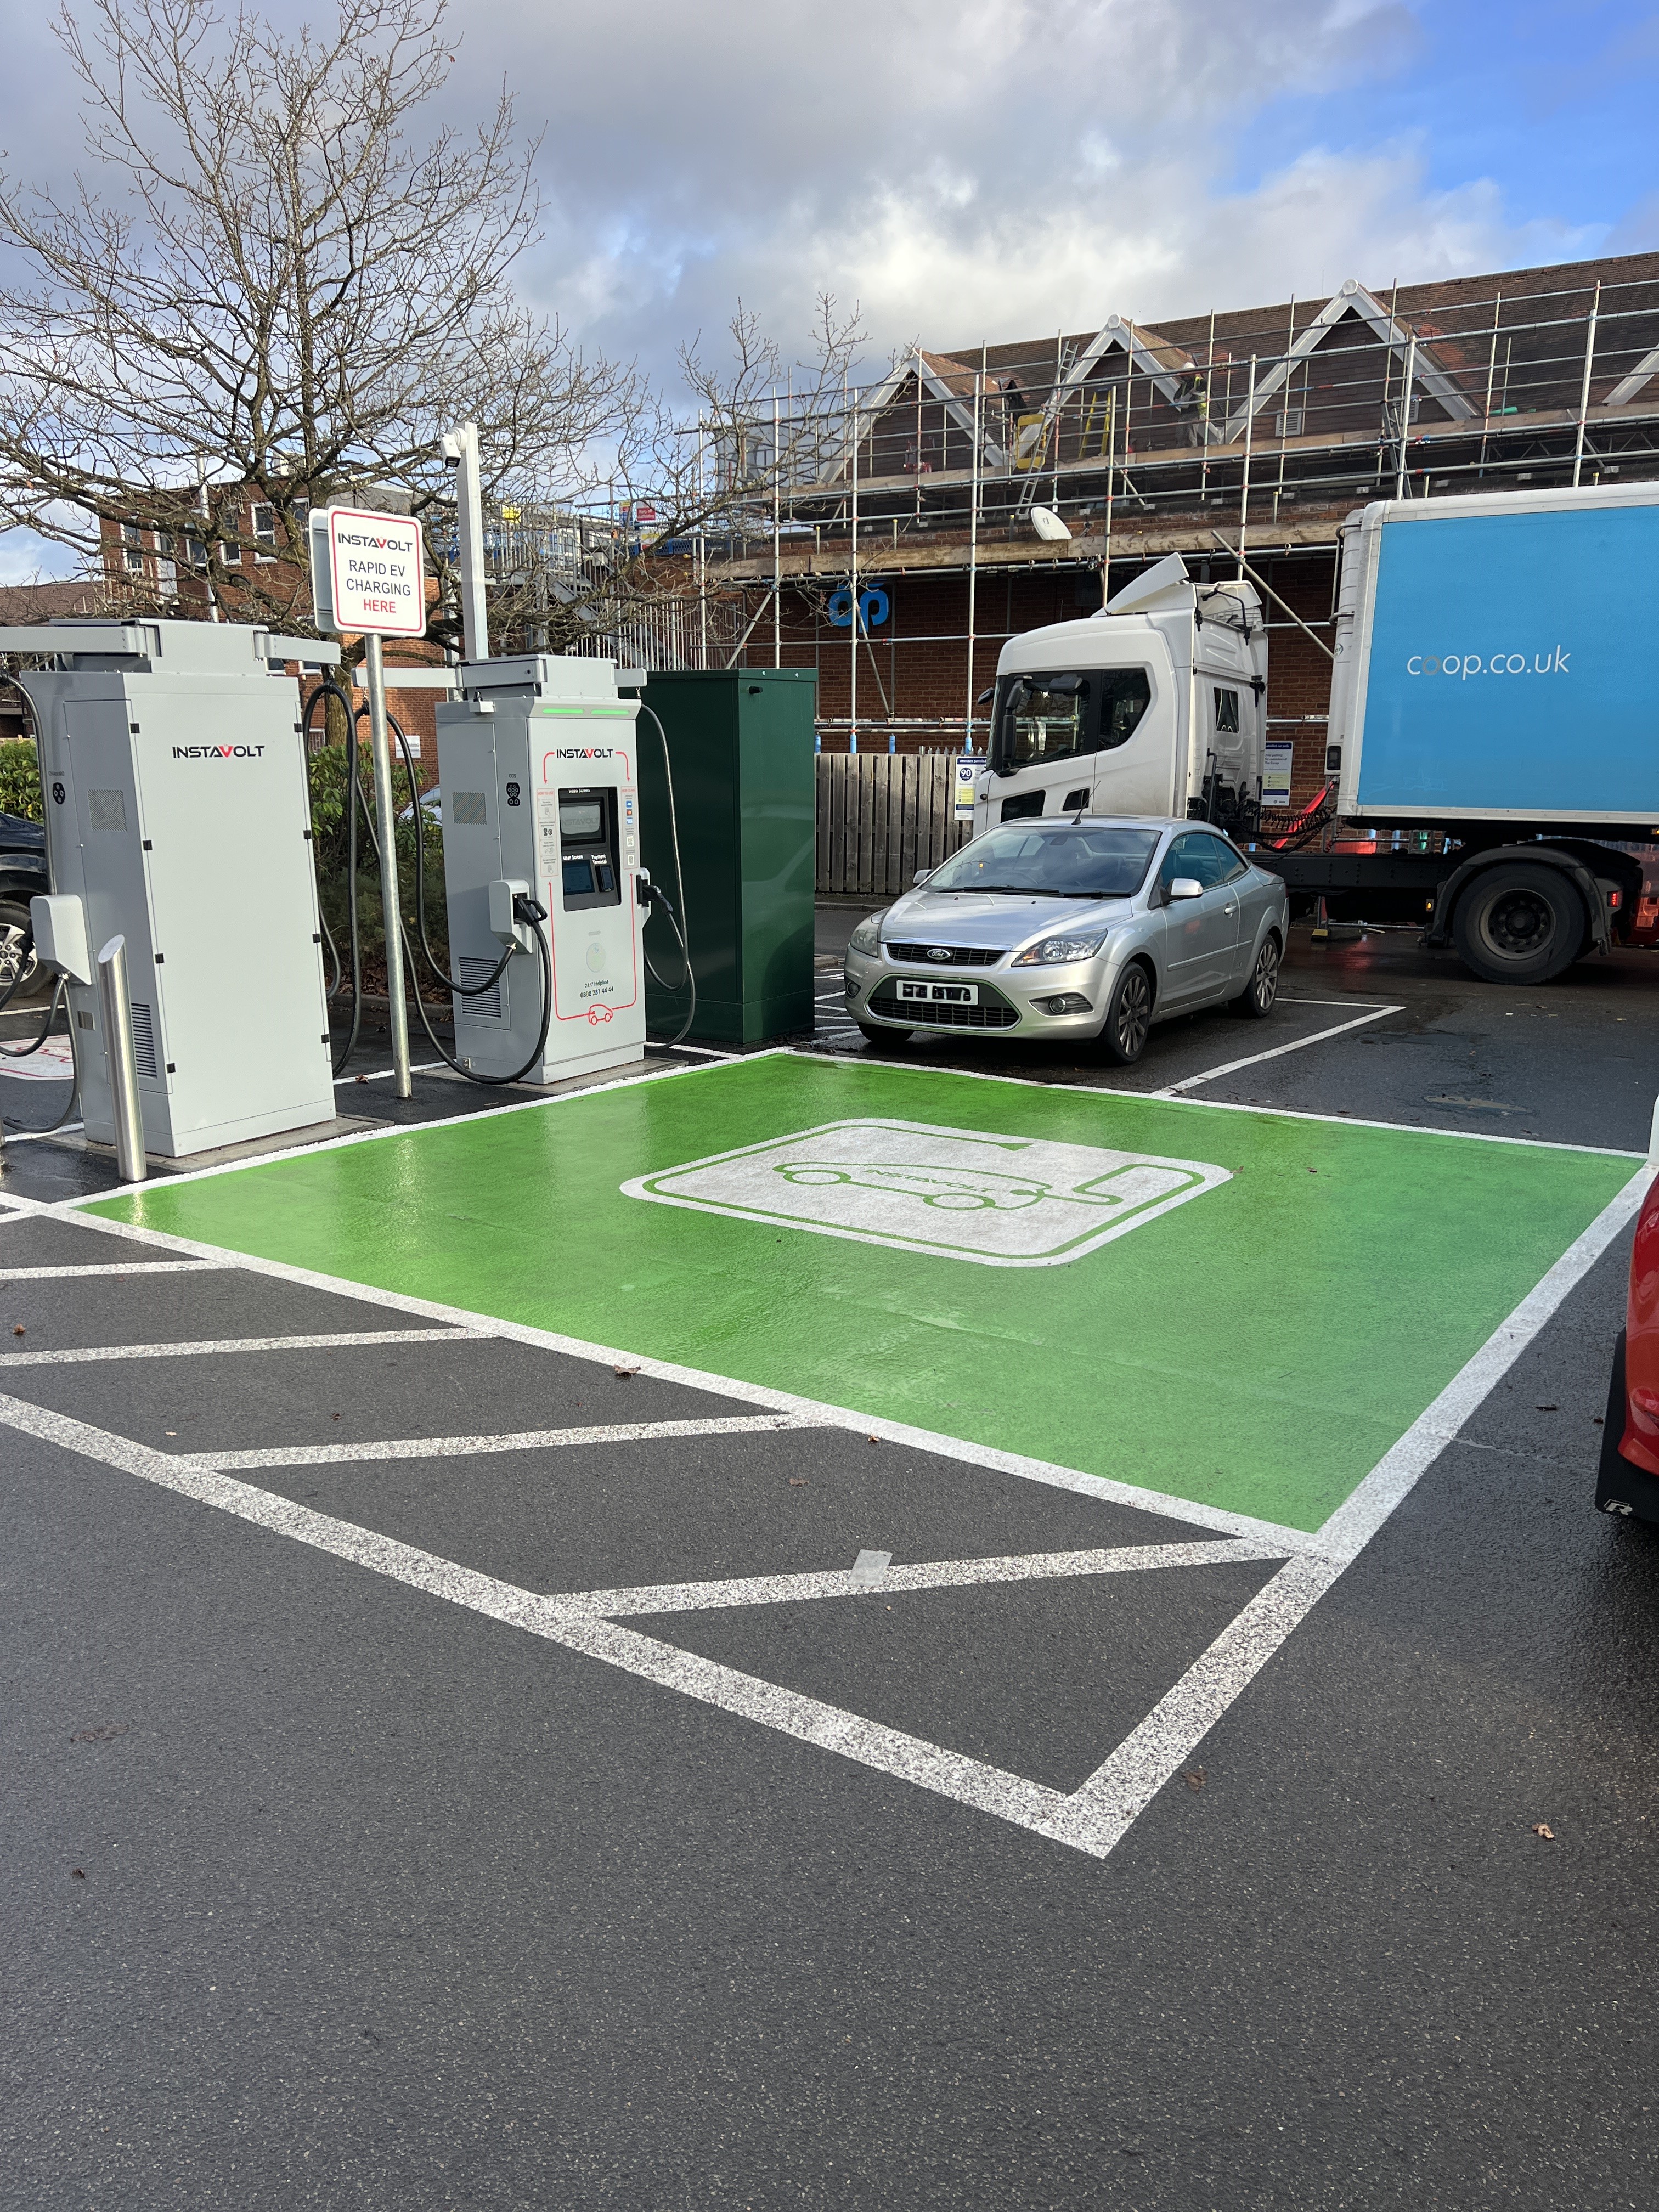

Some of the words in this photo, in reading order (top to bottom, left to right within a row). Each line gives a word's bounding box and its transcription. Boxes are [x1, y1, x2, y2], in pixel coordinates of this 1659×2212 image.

[338, 533, 413, 552] INSTAVOLT
[349, 560, 386, 575] RAPID
[391, 565, 405, 577] EV
[346, 578, 410, 596] CHARGING
[364, 599, 396, 613] HERE
[1407, 645, 1571, 680] coop.co.uk
[172, 744, 265, 758] INSTAVOLT
[556, 748, 613, 759] INSTAVOLT
[863, 1169, 1000, 1192] INSTAVOLT
